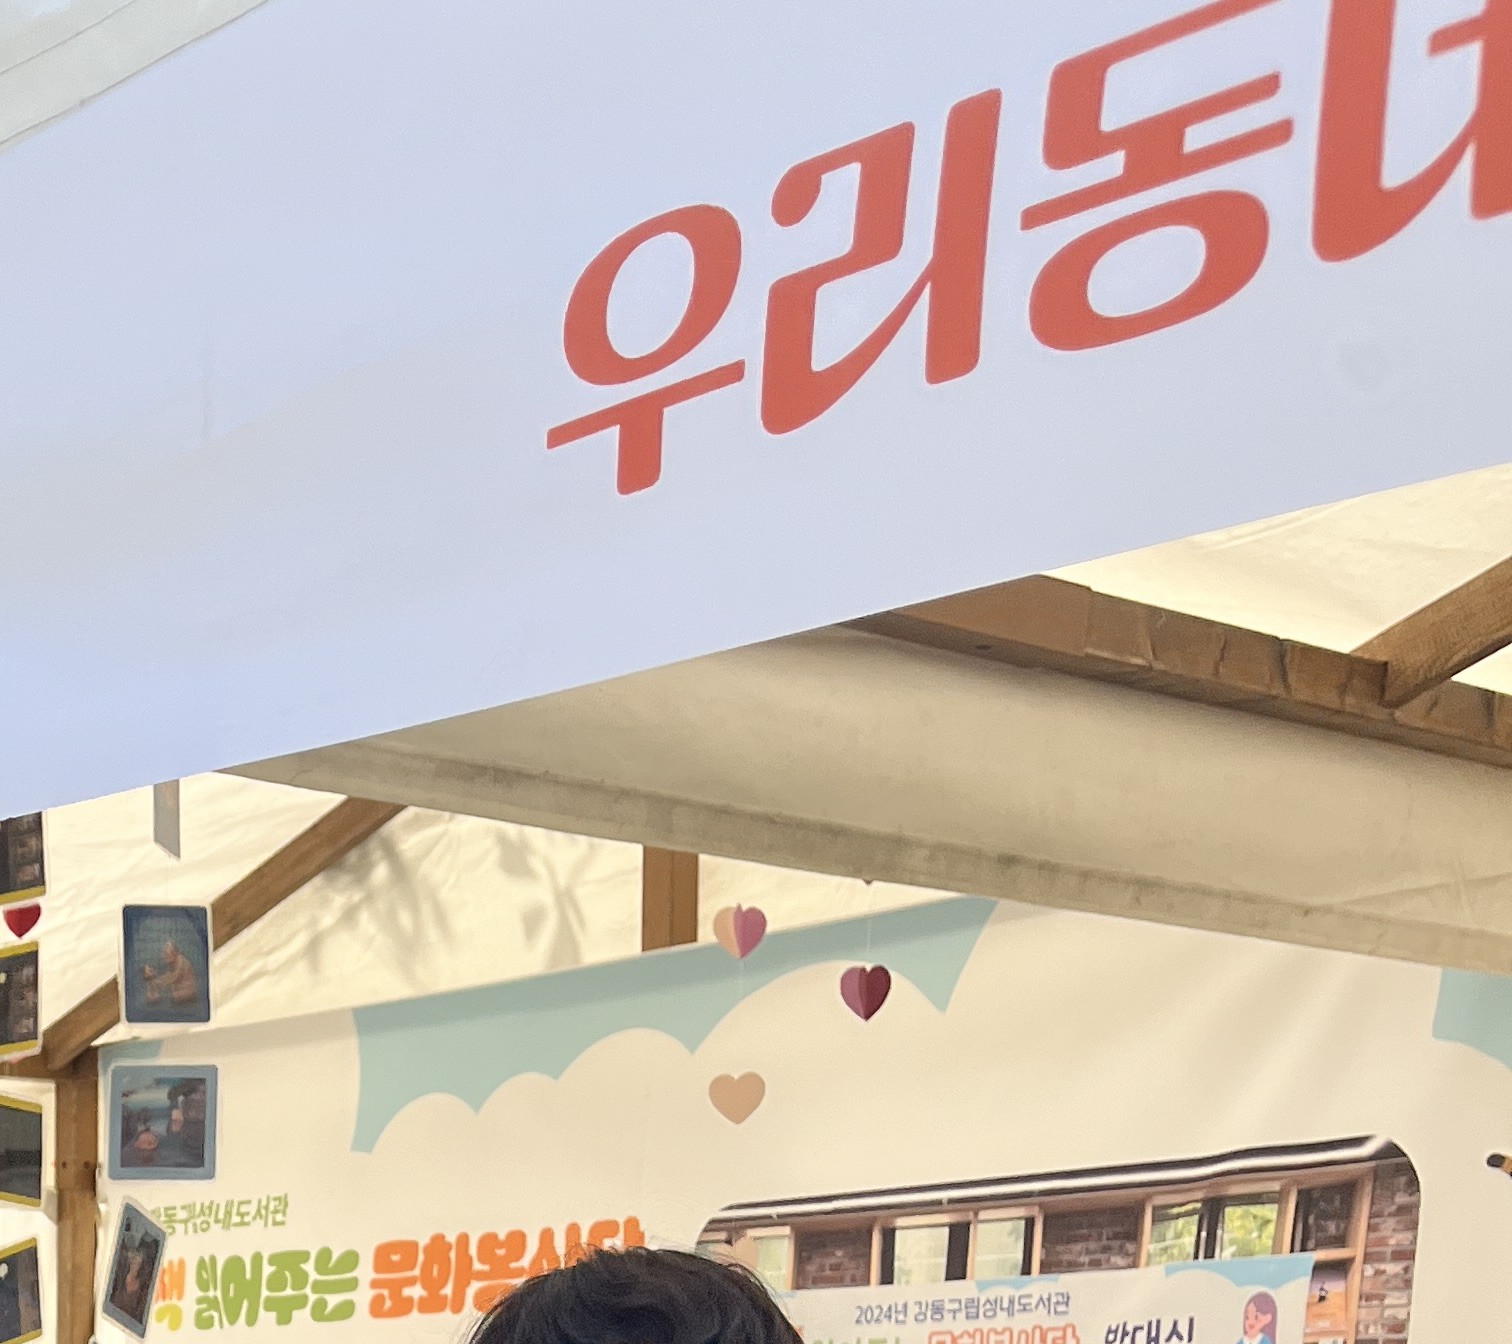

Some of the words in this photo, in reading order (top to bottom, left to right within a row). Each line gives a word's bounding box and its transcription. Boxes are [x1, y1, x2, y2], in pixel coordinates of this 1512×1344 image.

[193, 1245, 360, 1331] 읽어주는
[854, 1303, 909, 1326] 2024년
[913, 1291, 1071, 1324] 강동구립성내도서관
